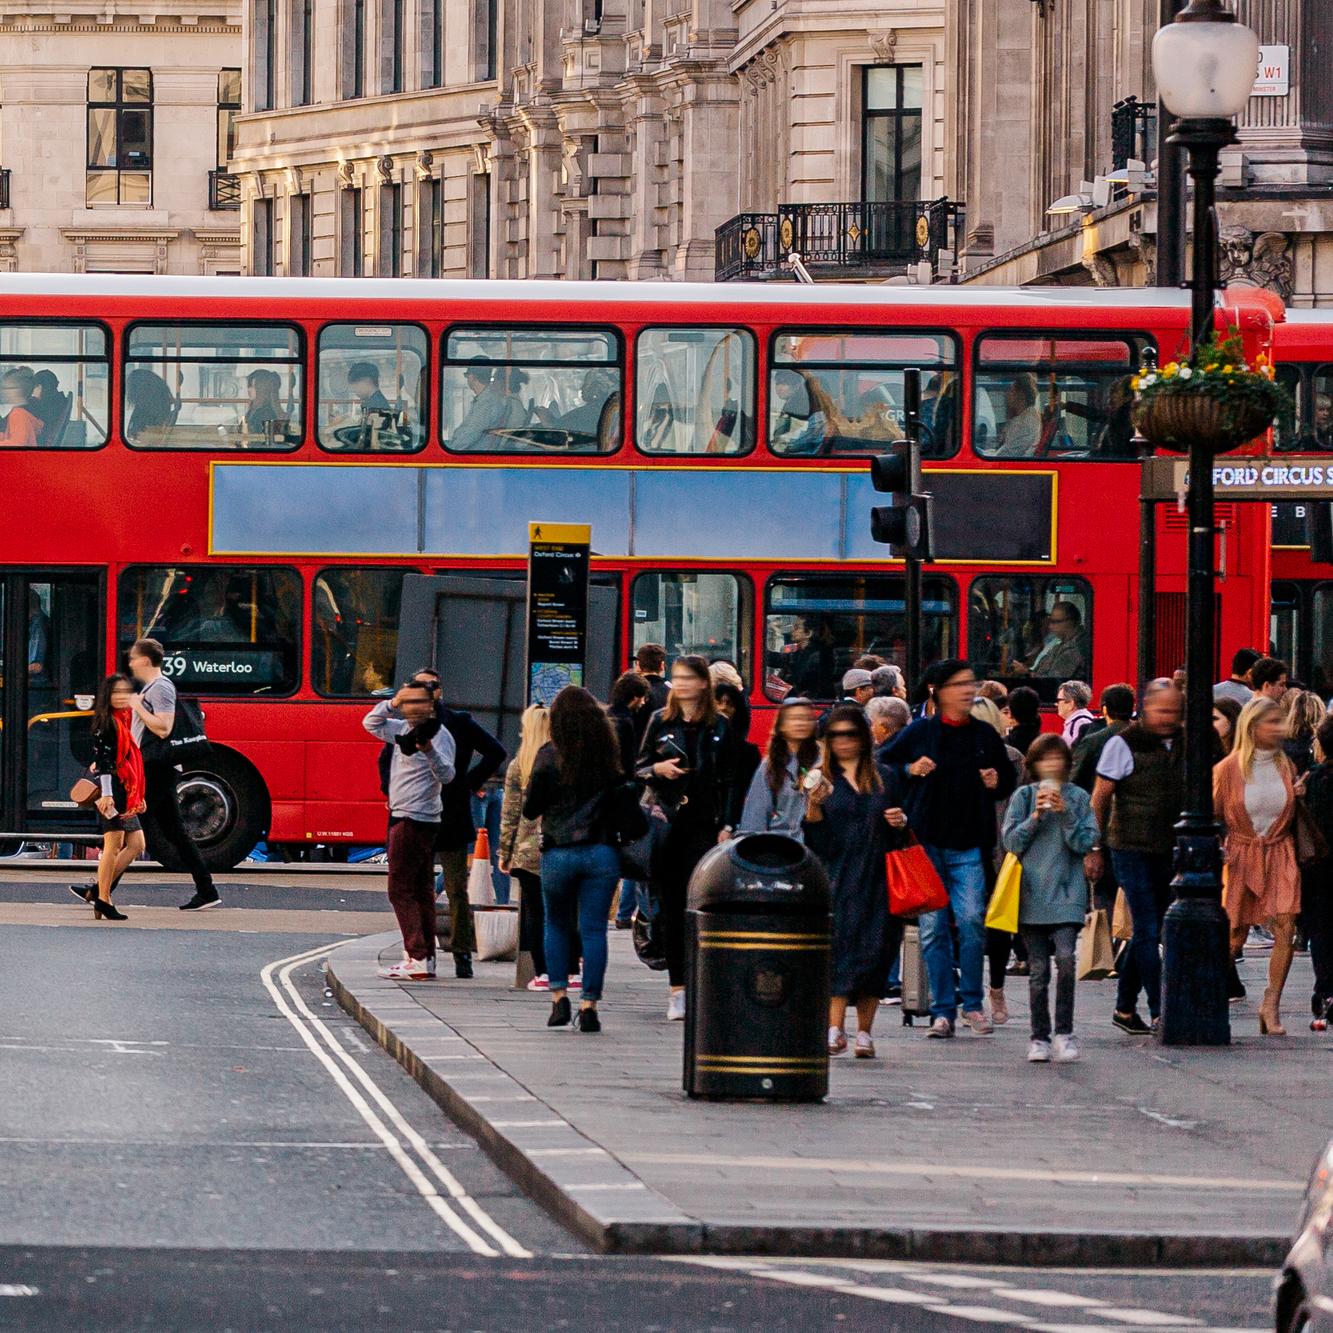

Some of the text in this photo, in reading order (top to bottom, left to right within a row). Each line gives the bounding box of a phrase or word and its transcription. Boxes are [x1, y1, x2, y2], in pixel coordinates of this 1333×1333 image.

[1264, 66, 1281, 79] W1
[1261, 466, 1324, 486] CIRCUS
[193, 661, 253, 674] Waterloo
